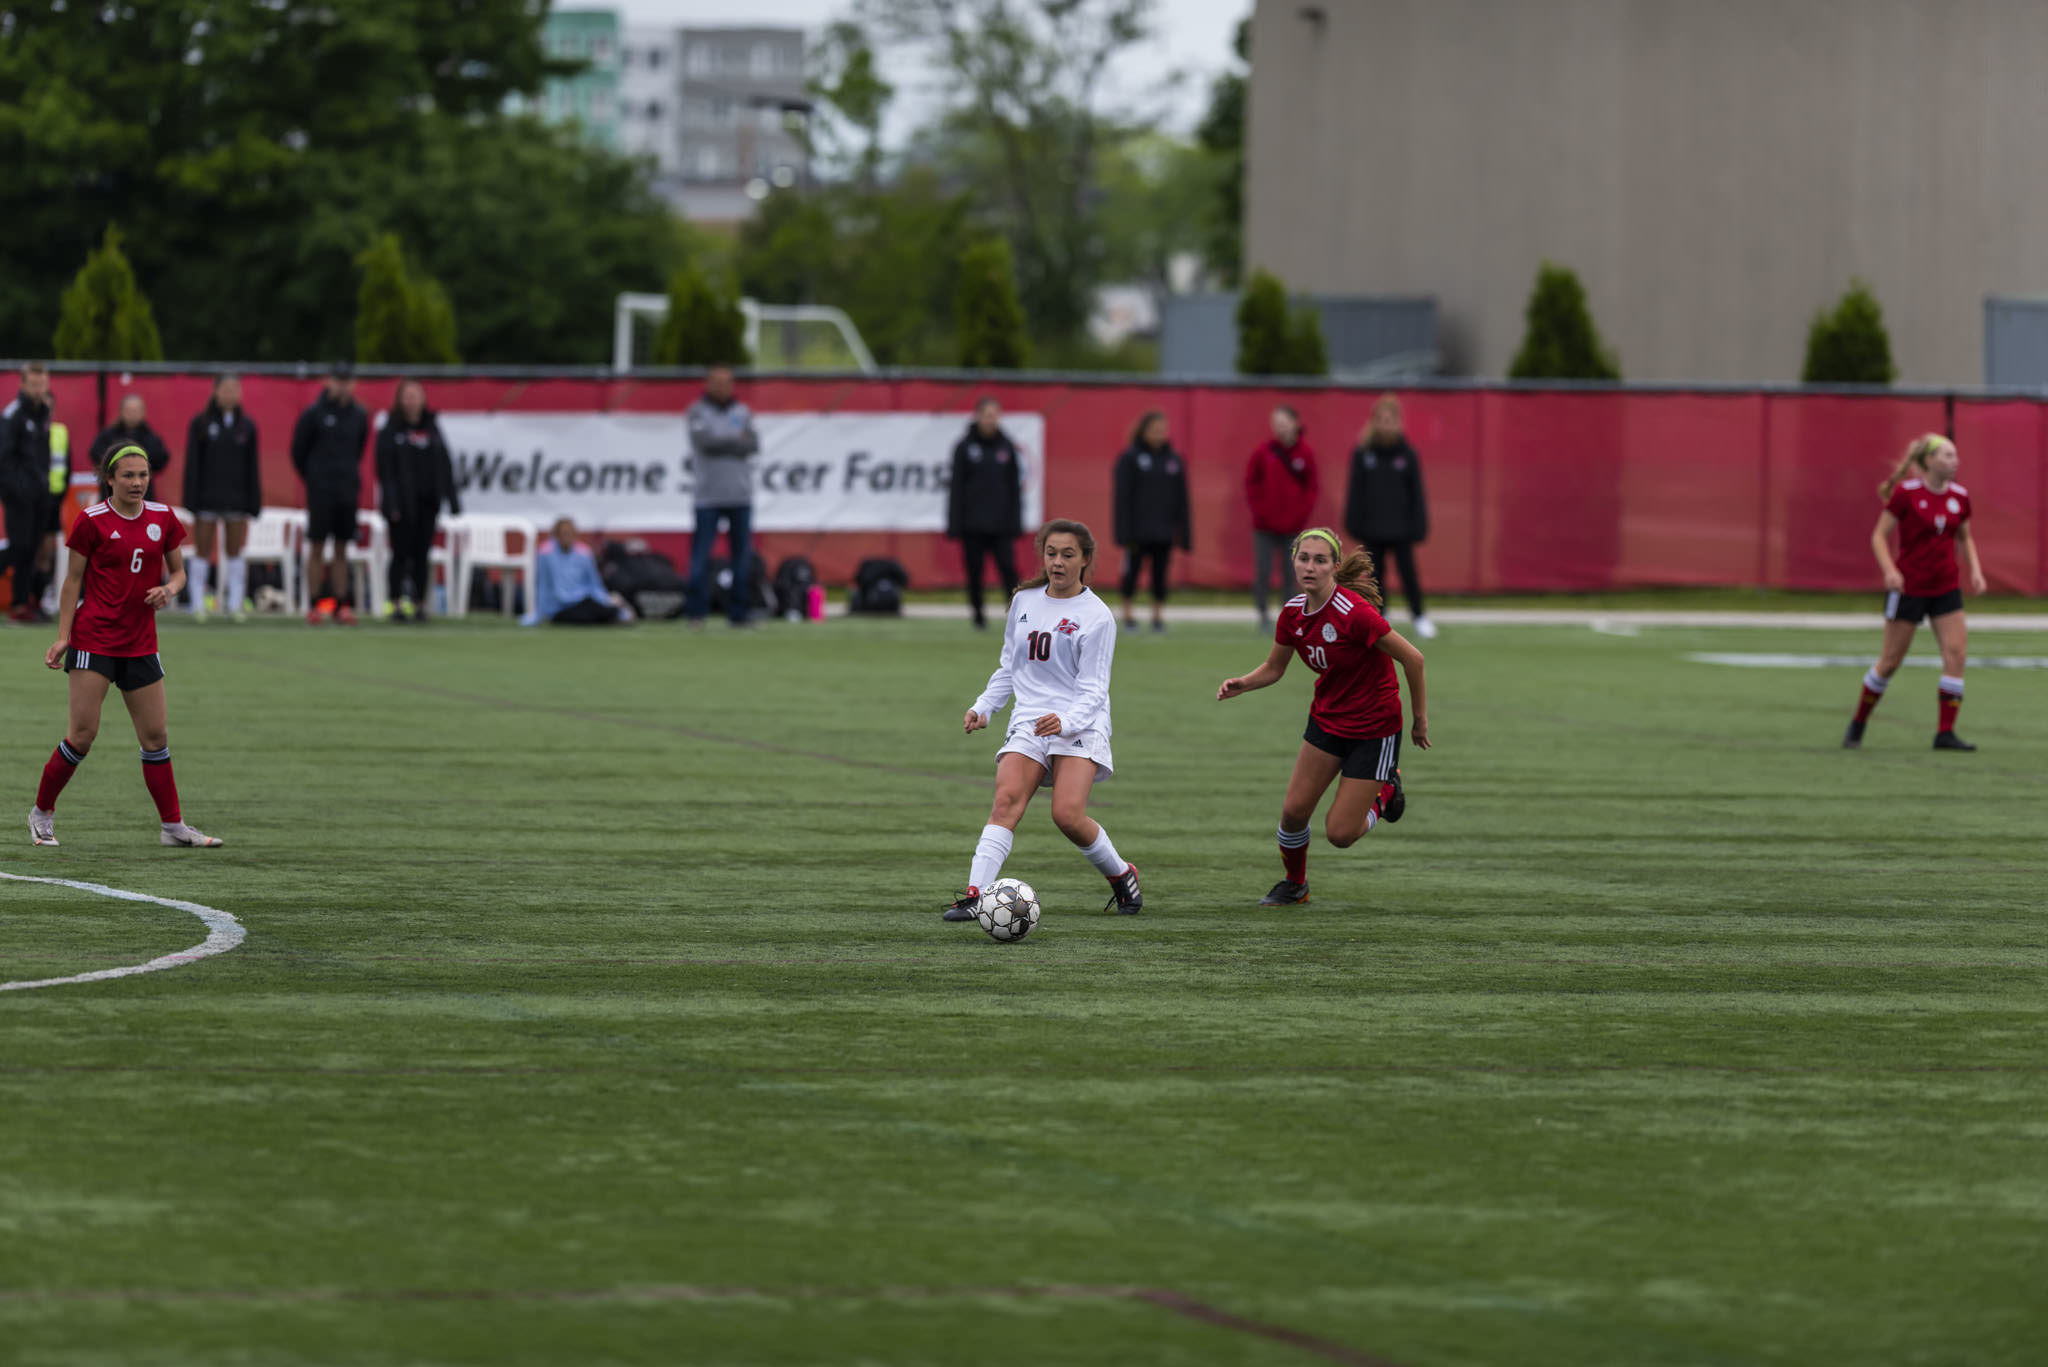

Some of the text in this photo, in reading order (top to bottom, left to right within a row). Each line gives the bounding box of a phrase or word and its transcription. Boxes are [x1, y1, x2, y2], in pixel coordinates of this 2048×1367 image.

[457, 452, 952, 493] Welcome Scer Fans
[130, 547, 145, 574] 6
[1027, 630, 1052, 662] 10
[1306, 645, 1328, 669] 20
